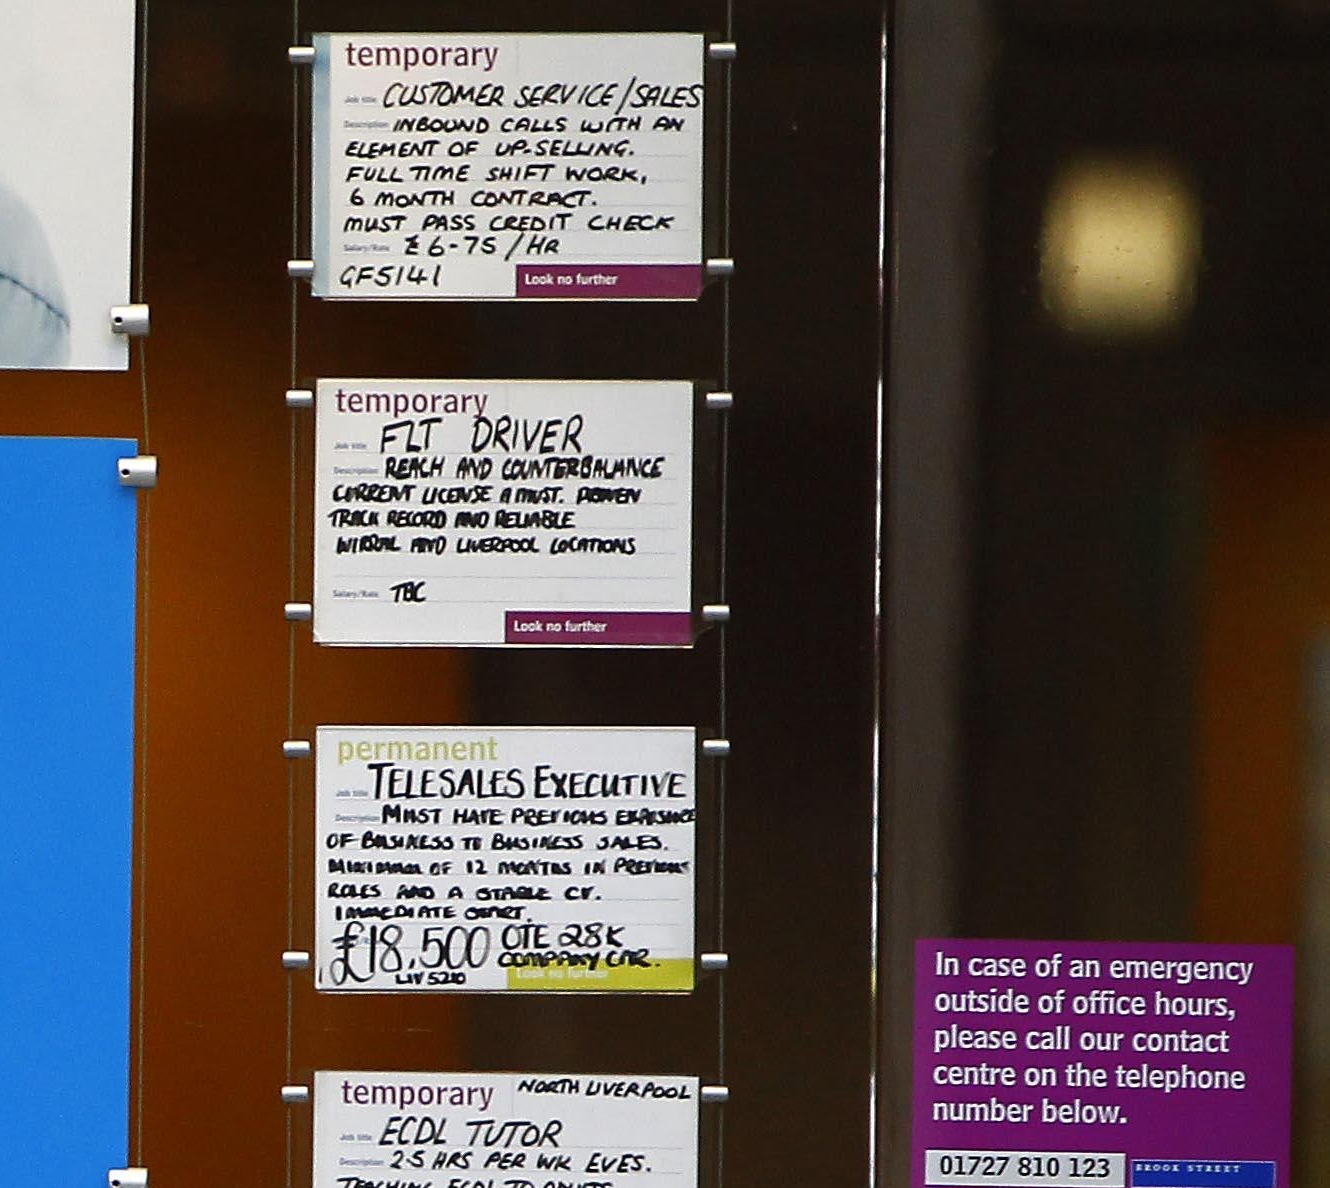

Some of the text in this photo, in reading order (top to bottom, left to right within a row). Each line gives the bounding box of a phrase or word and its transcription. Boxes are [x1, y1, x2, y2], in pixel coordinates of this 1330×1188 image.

[346, 43, 498, 71] temporary
[383, 75, 705, 115] CUSTOMER SERVICE/SALES
[393, 116, 684, 133] INBOUND CALLS WITH AN
[340, 265, 440, 288] GF5141
[525, 273, 617, 285] Look no further
[336, 389, 490, 422] temporary
[471, 409, 583, 454] DRIVER
[338, 737, 498, 768] permanent
[368, 763, 686, 799] TELESALES EXECUTIVE
[936, 952, 1253, 984] In case of an emergency
[935, 989, 1235, 1020] outside of office hours,
[934, 1024, 1229, 1052] please call our contact
[518, 1079, 691, 1099] NORTH LIVERPOOL
[934, 1063, 1245, 1092] centre on the telephone
[342, 1081, 493, 1111] temporary
[934, 1098, 1126, 1123] number below.
[379, 1116, 562, 1148] ECDL TUTOR
[940, 1156, 1109, 1180] 01727 810 123
